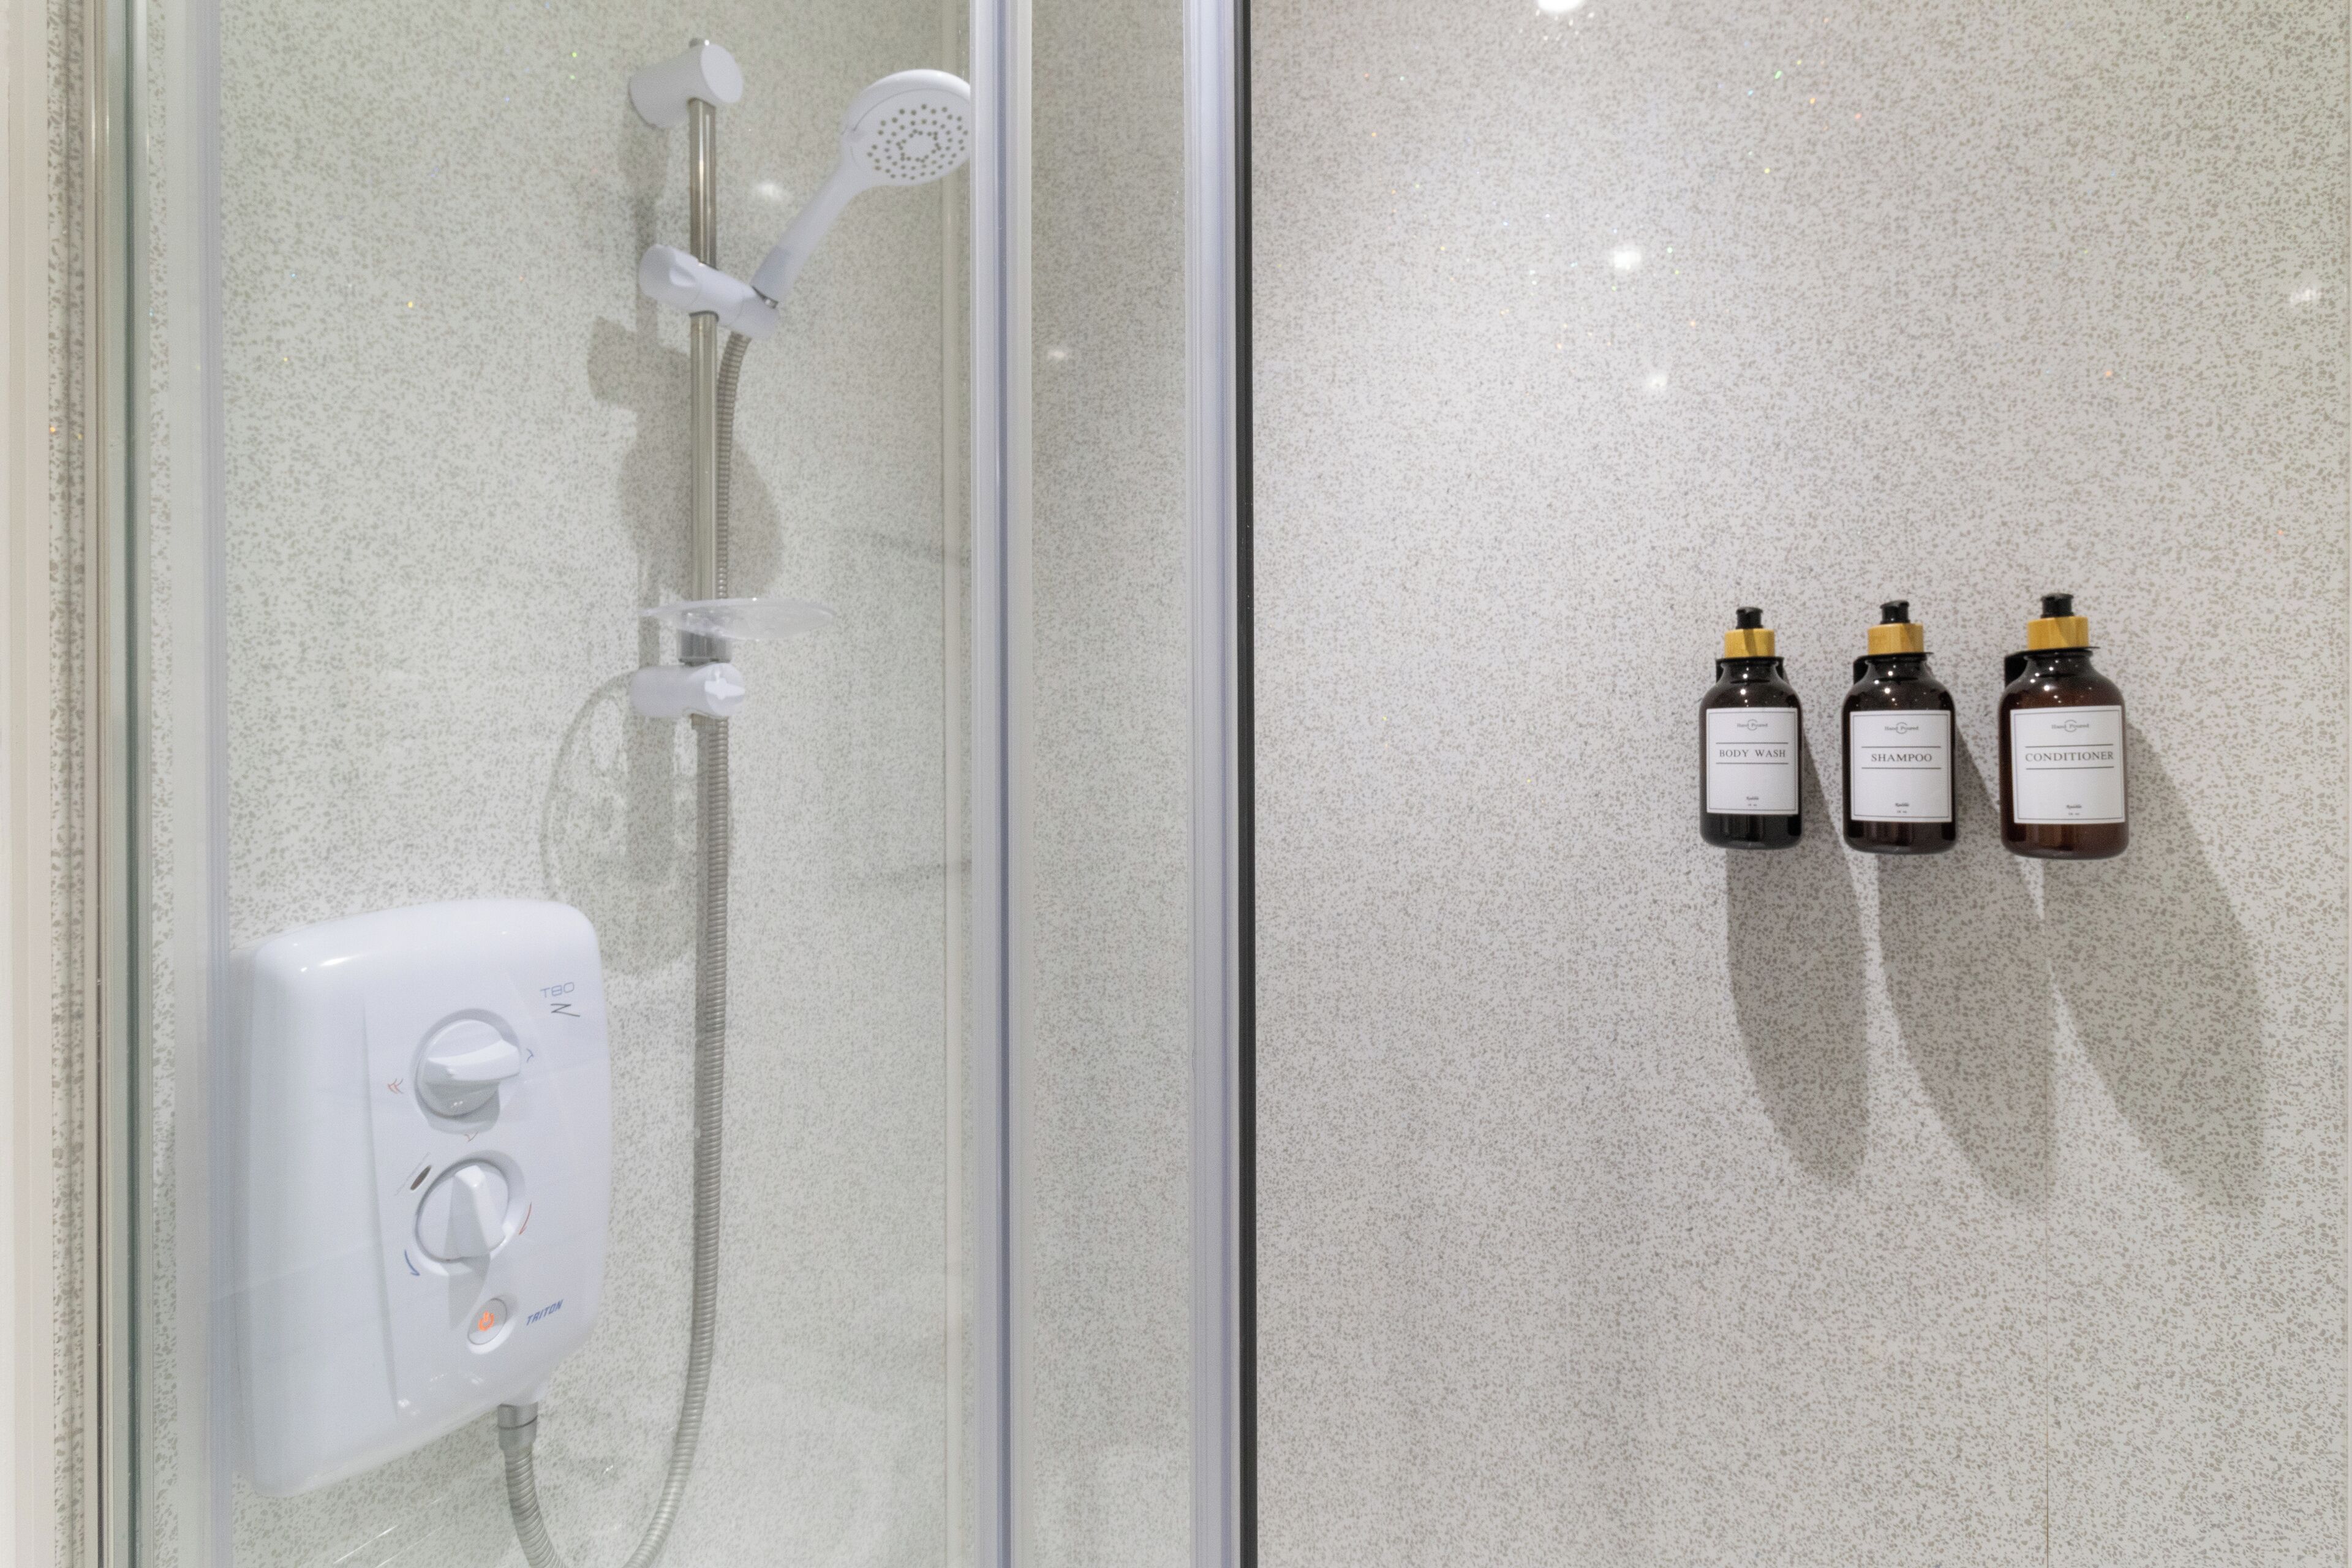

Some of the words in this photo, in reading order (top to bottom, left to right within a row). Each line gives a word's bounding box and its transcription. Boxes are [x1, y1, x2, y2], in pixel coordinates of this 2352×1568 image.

[1719, 749, 1749, 758] BODY
[1755, 749, 1786, 758] WASH
[1871, 753, 1932, 763] SHAMPOO
[2025, 751, 2114, 763] CONDITIONER
[527, 1299, 564, 1326] TRITON
